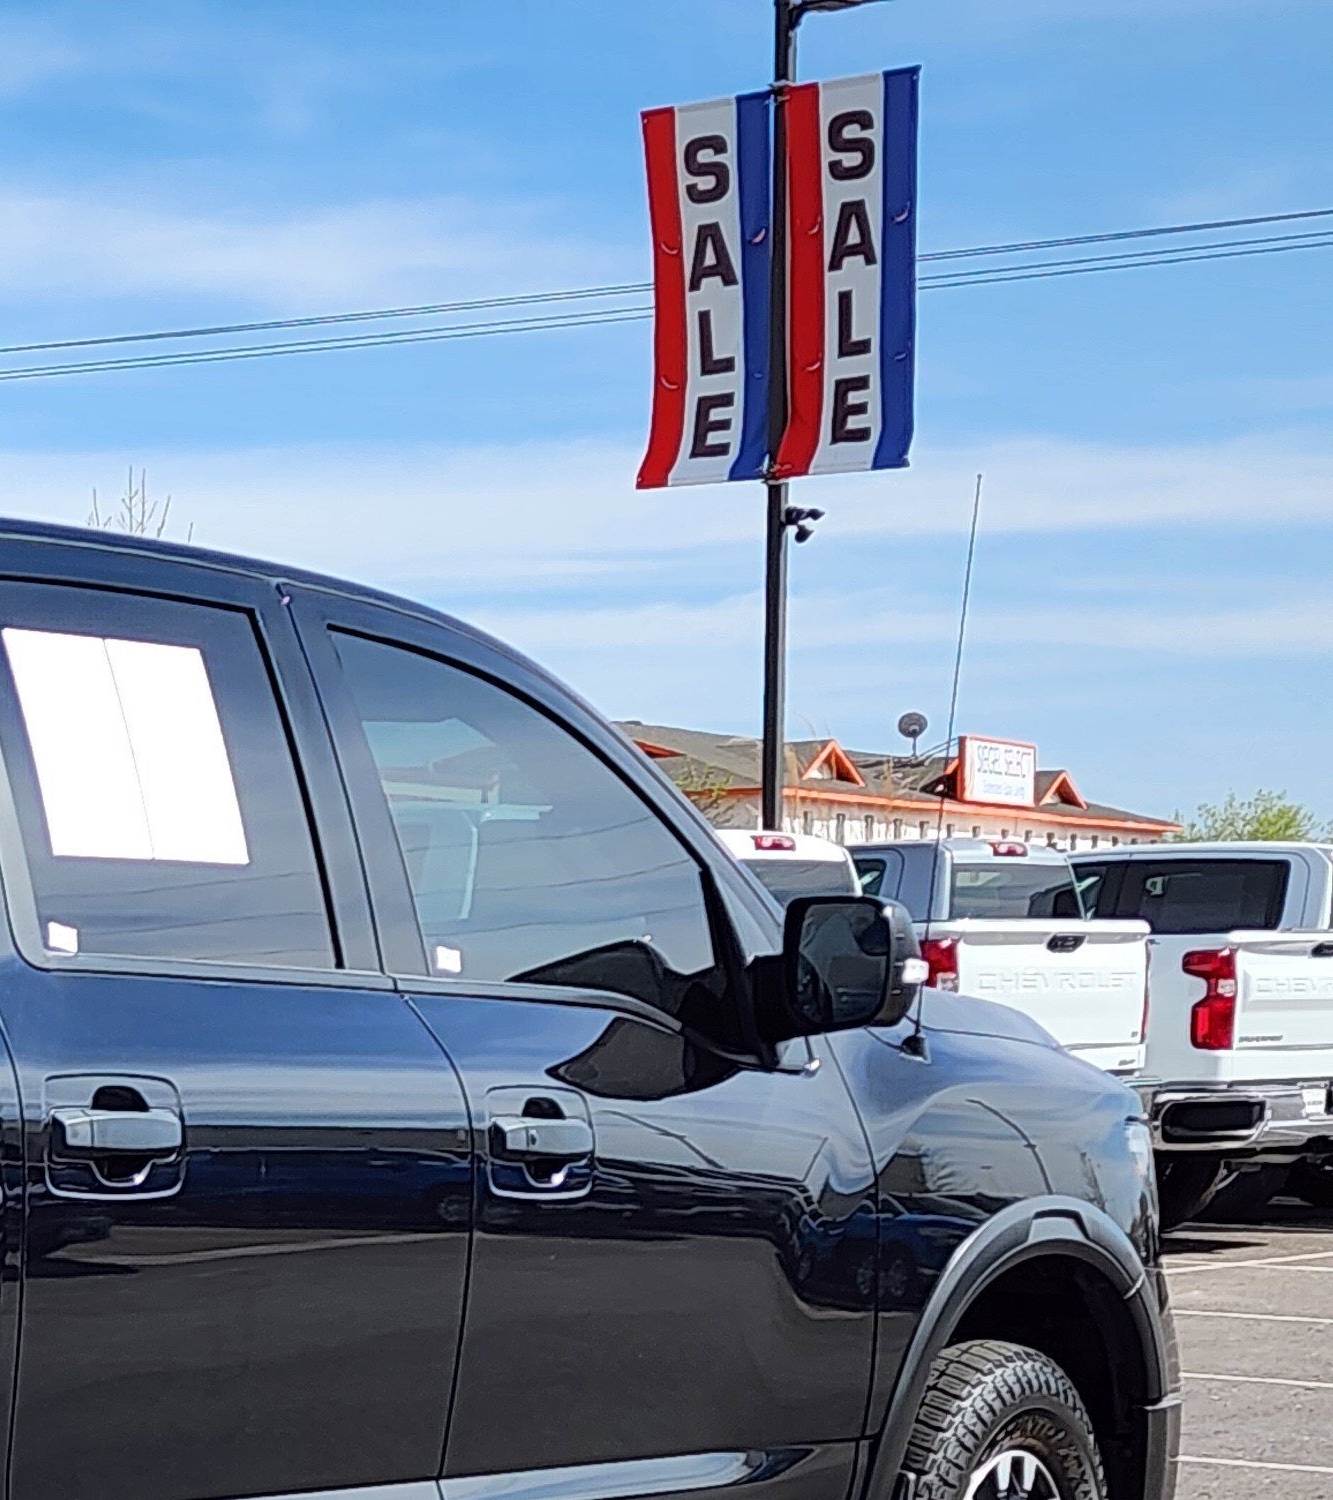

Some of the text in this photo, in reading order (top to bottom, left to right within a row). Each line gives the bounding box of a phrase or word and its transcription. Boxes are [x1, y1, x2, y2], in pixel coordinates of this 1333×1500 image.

[683, 134, 739, 459] SALE
[827, 109, 877, 445] SALE
[978, 971, 1138, 990] CHEVROLET
